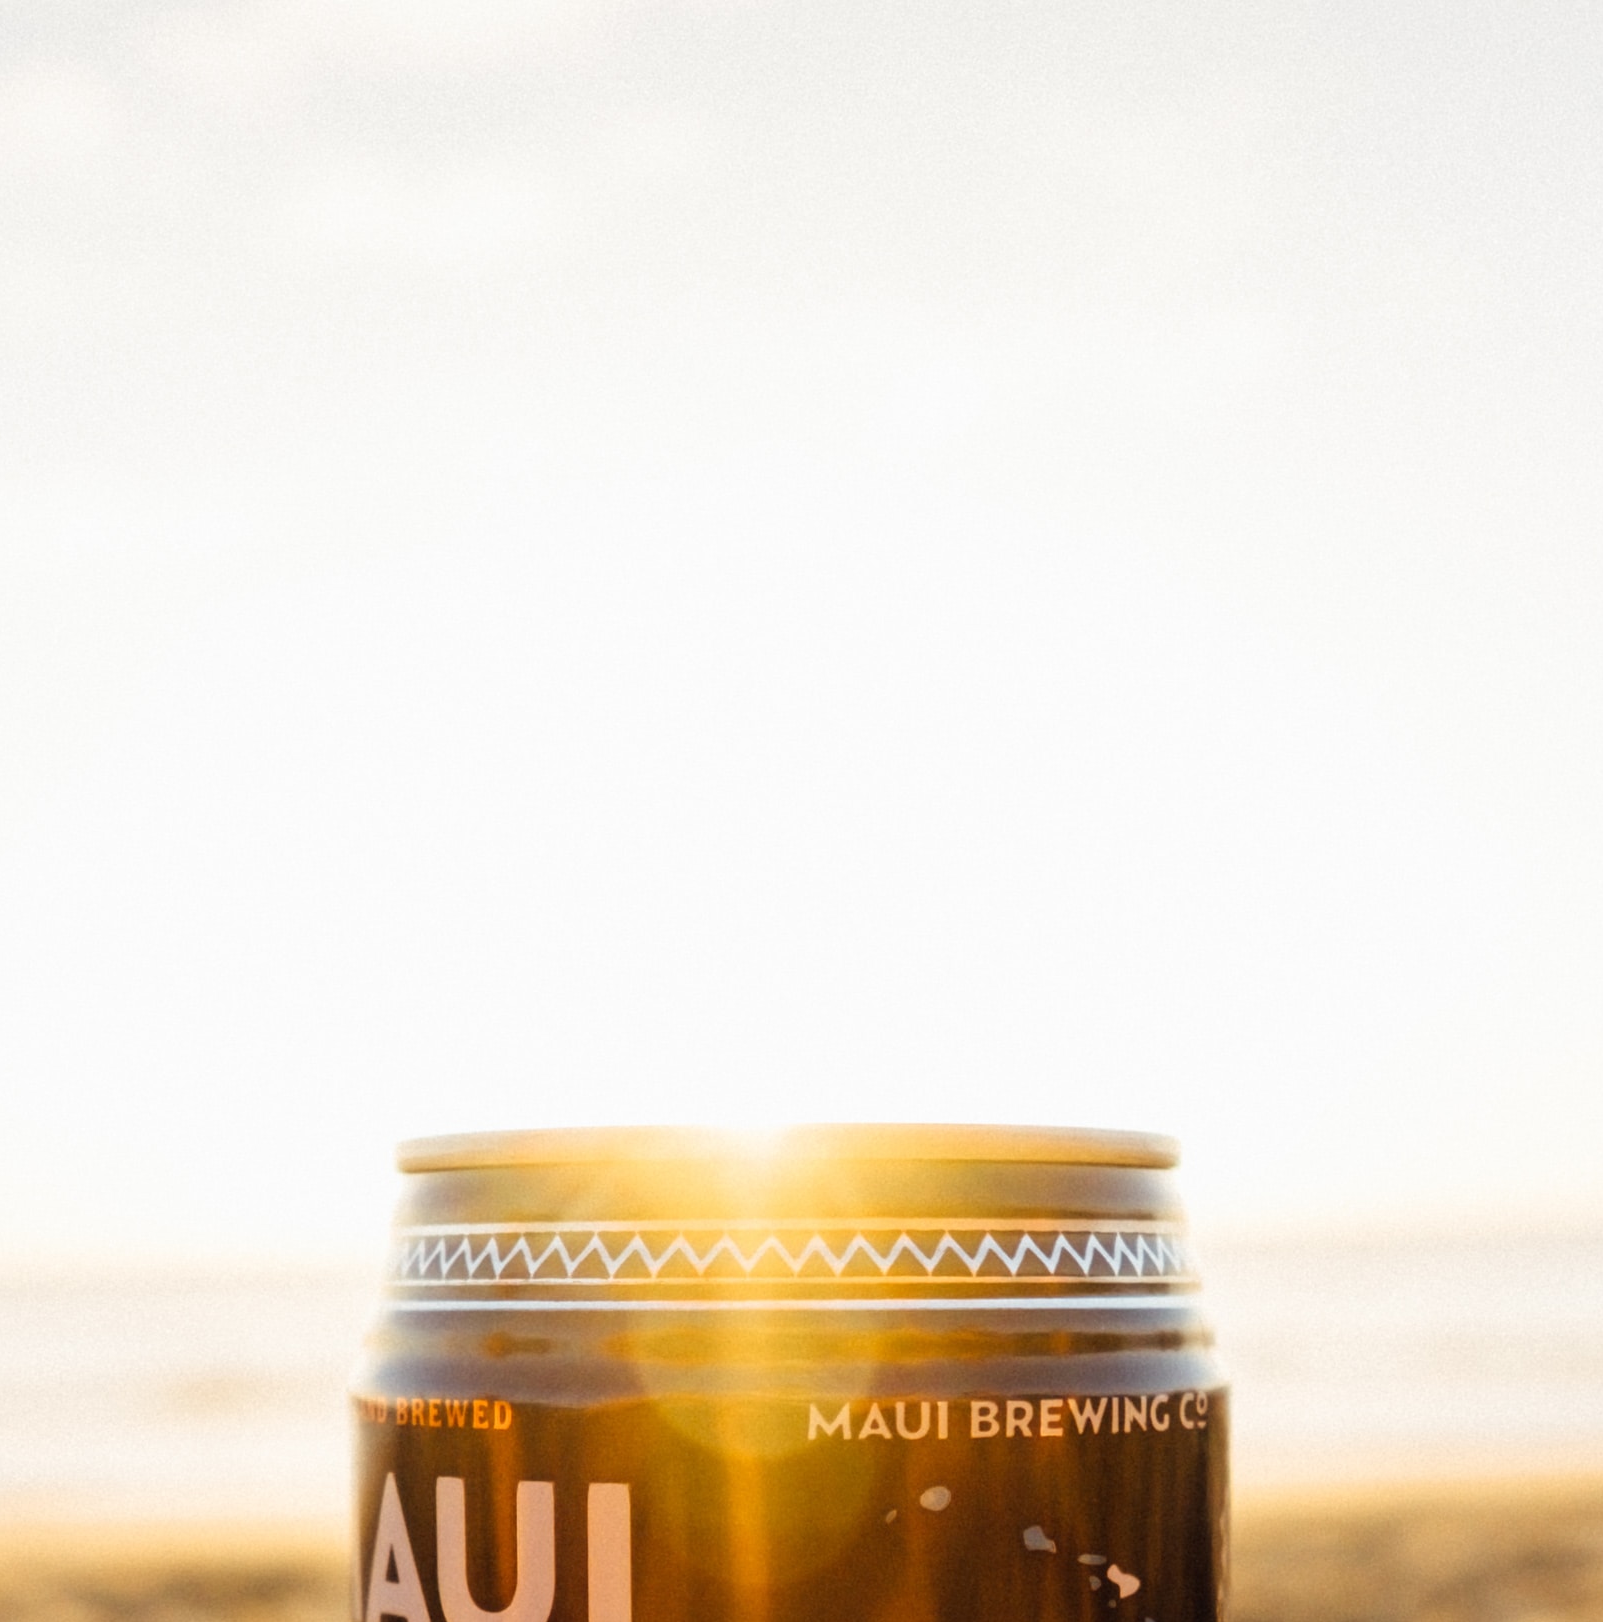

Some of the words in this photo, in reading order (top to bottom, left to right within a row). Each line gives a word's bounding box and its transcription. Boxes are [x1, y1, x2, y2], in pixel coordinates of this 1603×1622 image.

[395, 1397, 513, 1430] BREWED
[807, 1401, 950, 1442] MAUI
[969, 1393, 1170, 1439] BREWING
